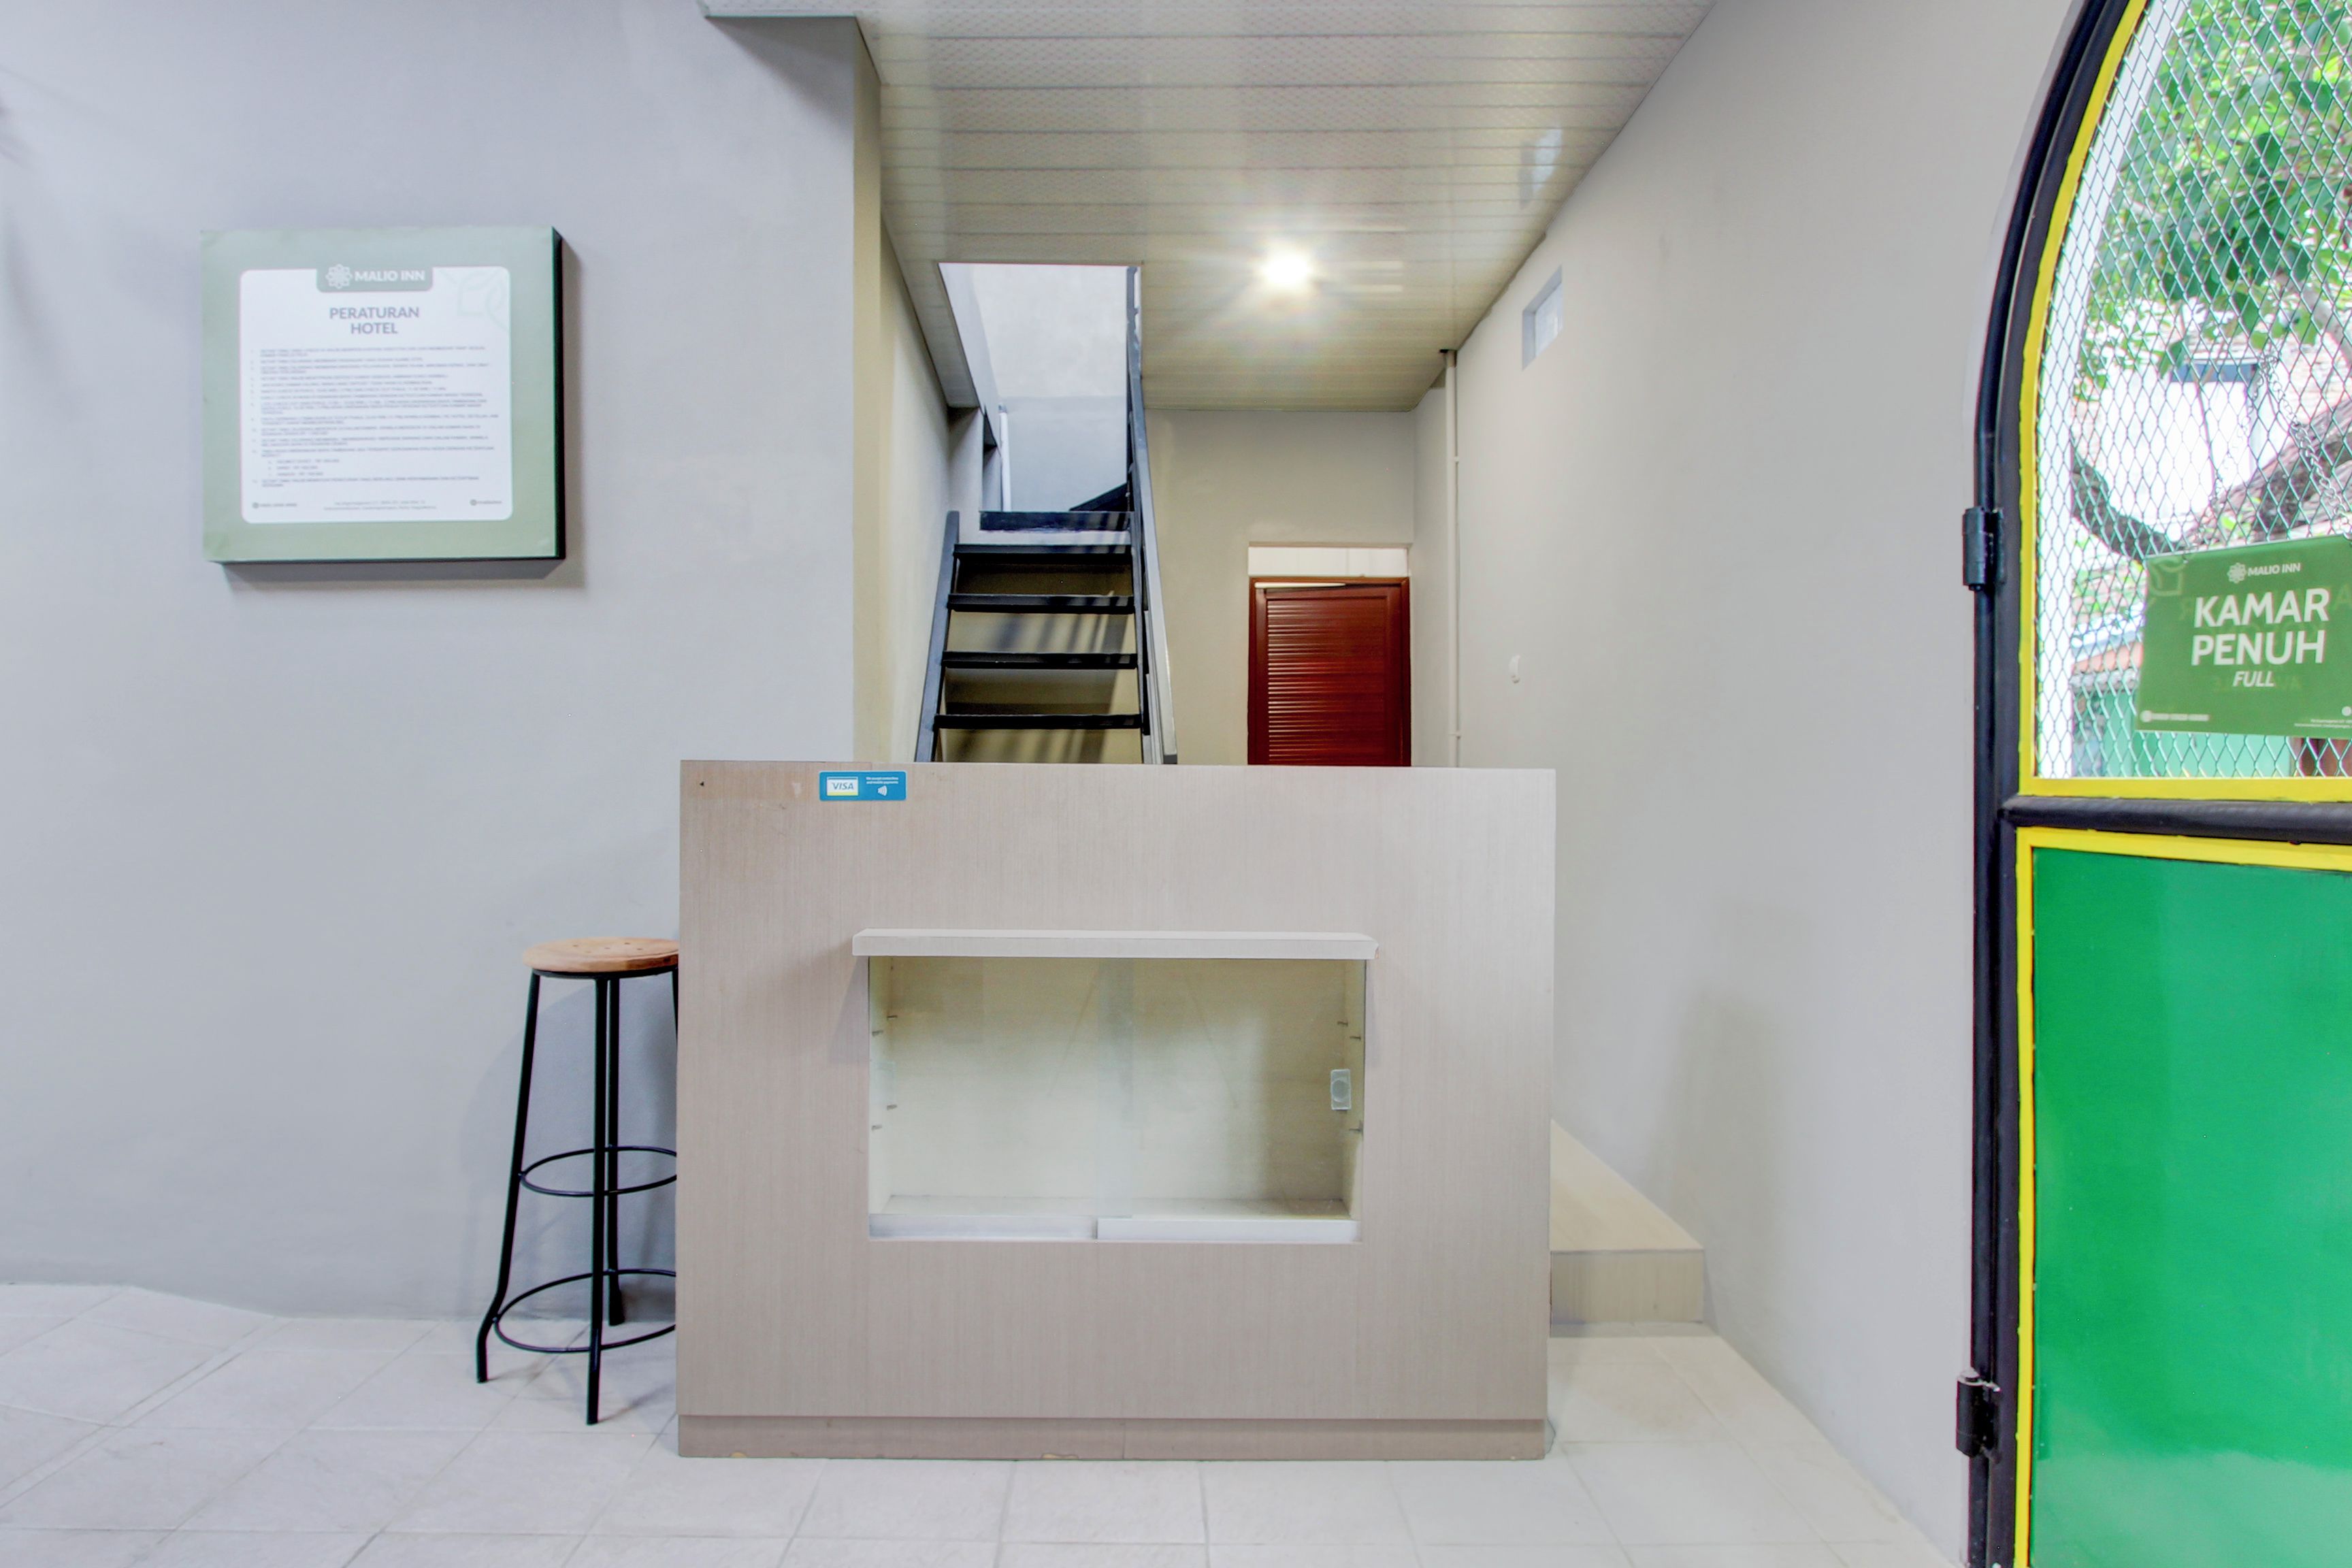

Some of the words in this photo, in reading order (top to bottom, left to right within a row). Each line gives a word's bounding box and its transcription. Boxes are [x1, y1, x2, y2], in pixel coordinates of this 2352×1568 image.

[355, 270, 397, 282] MALIO
[400, 270, 426, 282] INN
[329, 306, 420, 320] PERATURAN
[350, 321, 398, 335] HOTEL
[2248, 564, 2280, 576] MALIO
[2282, 563, 2300, 573] INN
[2193, 587, 2330, 628] KAMAR
[2191, 630, 2325, 666] PENUH
[2232, 670, 2274, 687] FULL
